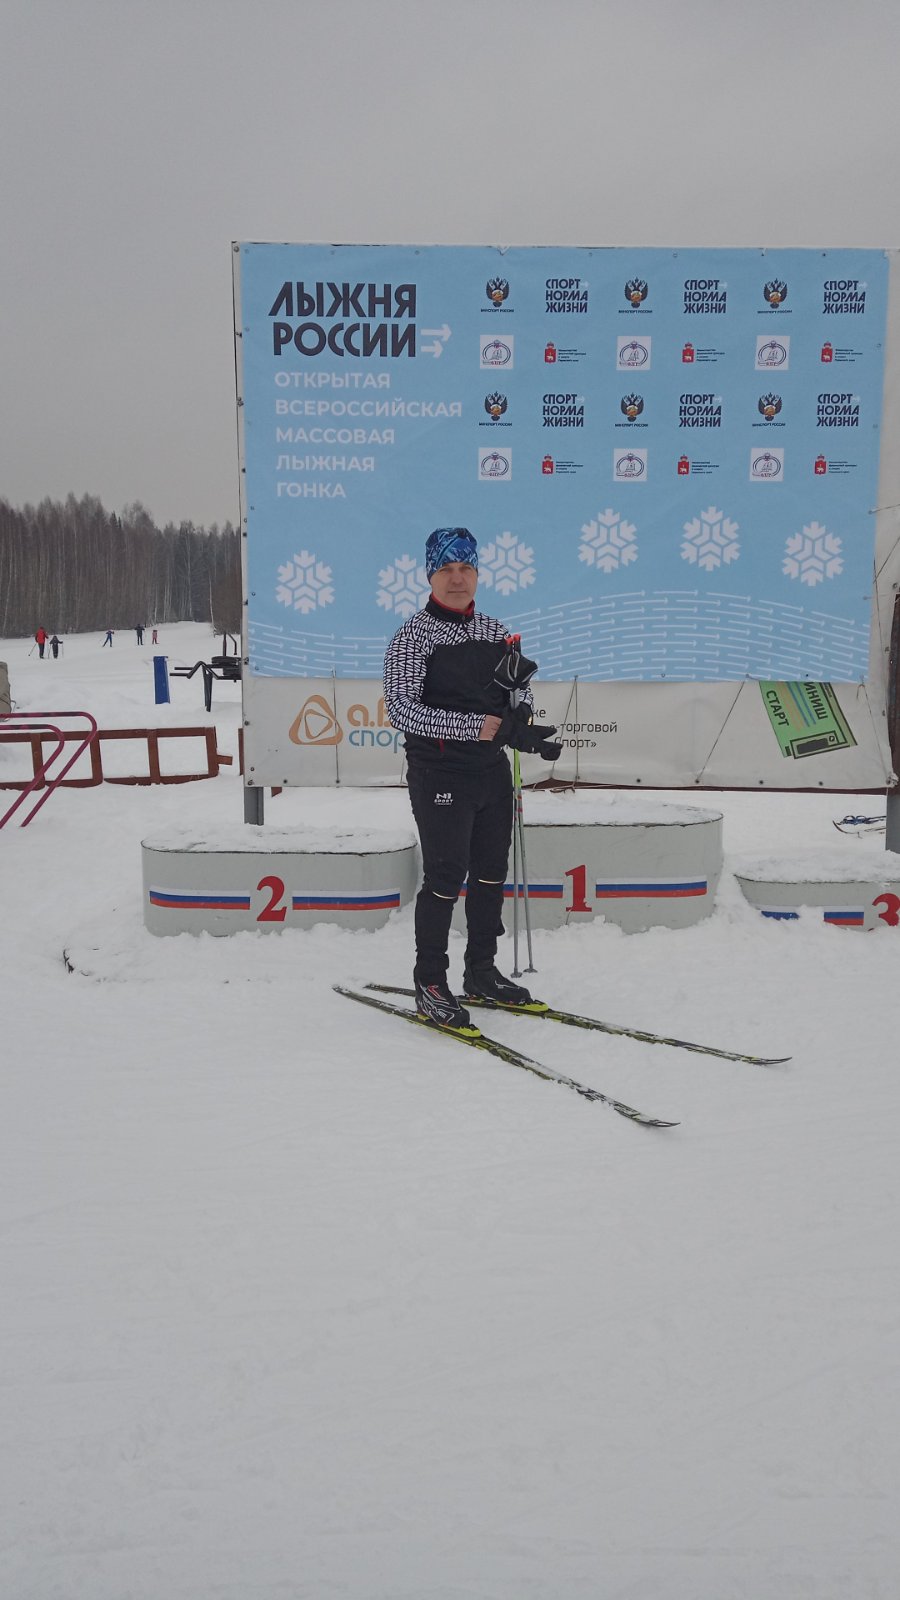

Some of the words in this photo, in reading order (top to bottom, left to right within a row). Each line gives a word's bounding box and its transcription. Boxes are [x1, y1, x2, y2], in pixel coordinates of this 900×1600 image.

[546, 279, 581, 289] СПОРТ
[684, 280, 720, 290] СПОРТ
[824, 280, 859, 290] СПОРТ
[268, 281, 416, 318] ЛЫЖНЯ
[546, 290, 588, 301] НОРМА
[684, 292, 726, 302] НОРМА
[824, 292, 865, 302] НОРМА
[546, 302, 587, 313] ЖИЗНИ
[683, 303, 726, 313] ЖИЗНИ
[823, 303, 865, 314] ЖИЗНИ
[273, 322, 416, 357] РОССИИ
[274, 372, 390, 388] ОТКРЫТАЯ
[543, 394, 577, 404] СПОРТ
[680, 394, 714, 404] СПОРТ
[818, 394, 853, 404] СПОРТ
[276, 398, 462, 417] ВСЕРОССИЙСКАЯ
[543, 406, 584, 415] НОРМА
[679, 406, 721, 416] НОРМА
[817, 405, 859, 415] НОРМА
[542, 417, 583, 427] ЖИЗНИ
[679, 417, 721, 427] ЖИЗНИ
[816, 416, 858, 426] ЖИЗНИ
[276, 427, 394, 444] МАССОВАЯ
[276, 455, 374, 471] ЛЫЖНАЯ
[277, 482, 346, 498] ГОНКА
[766, 690, 789, 726] СТАРТ
[565, 864, 592, 912] 1
[256, 876, 287, 922] 2
[872, 893, 900, 926] 3
